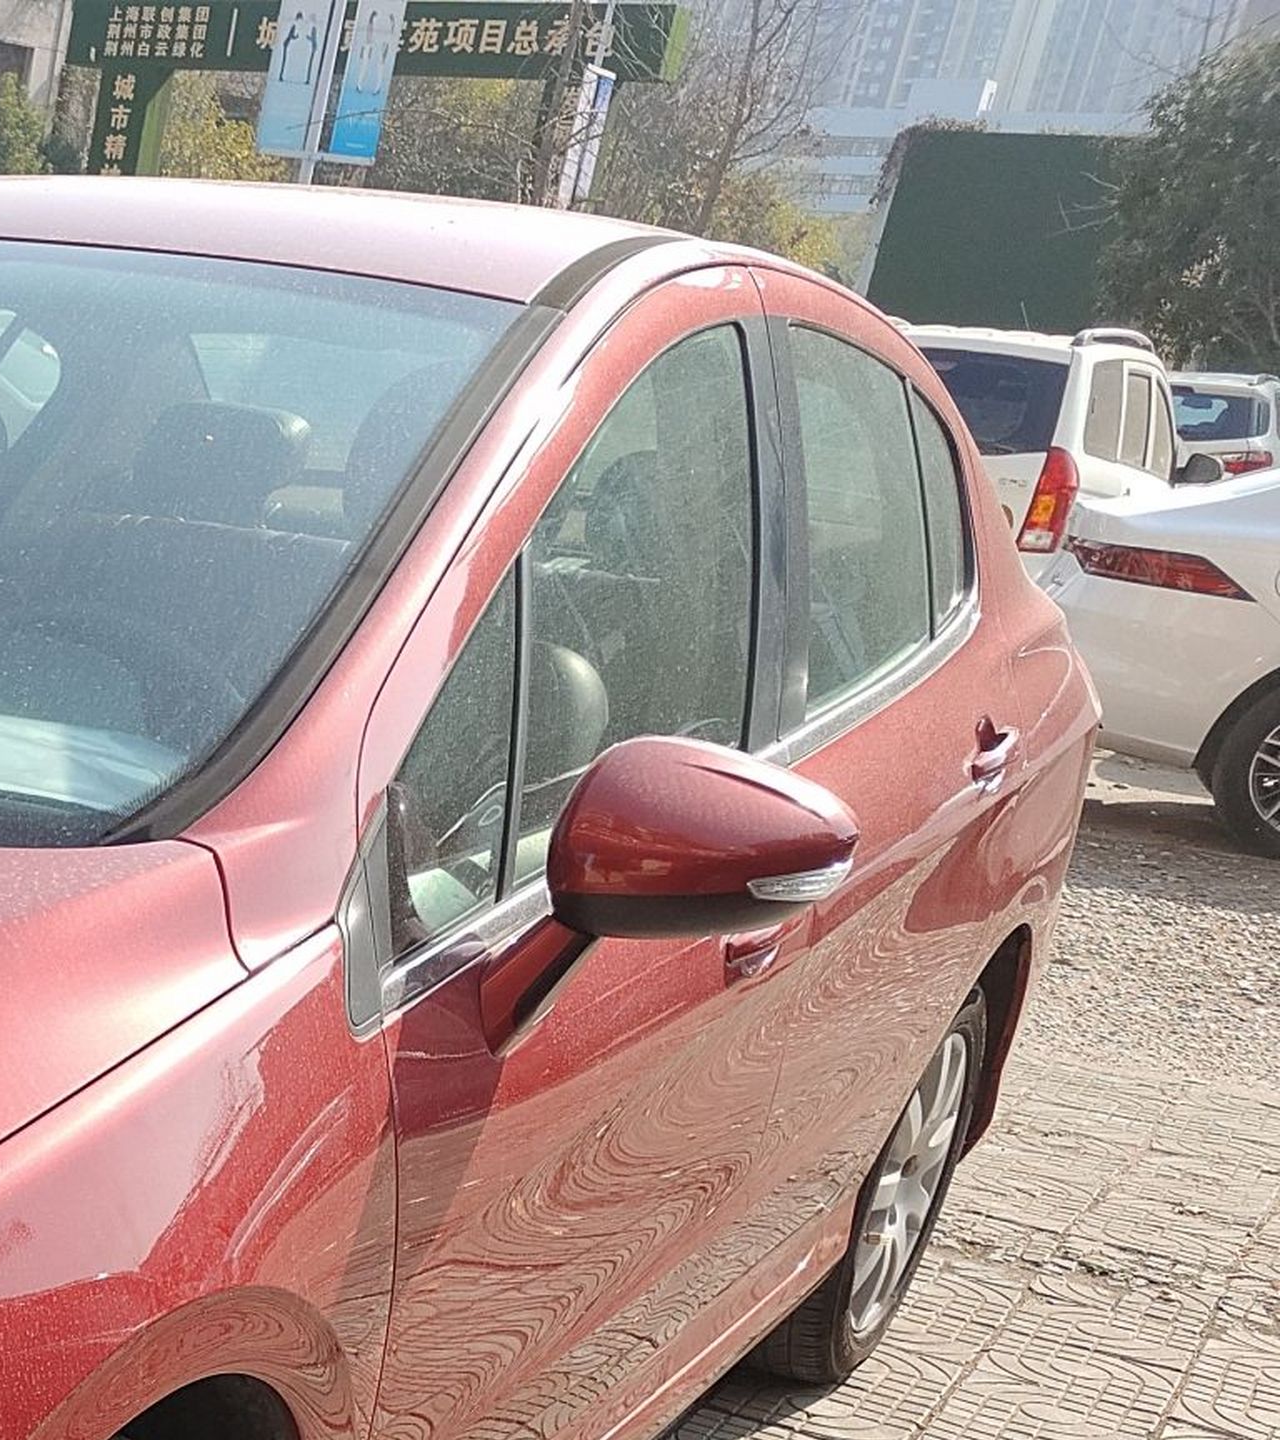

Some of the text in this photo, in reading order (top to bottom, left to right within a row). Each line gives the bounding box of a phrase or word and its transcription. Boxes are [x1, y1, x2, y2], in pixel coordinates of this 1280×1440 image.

[106, 23, 207, 40] 荆州市政集团
[103, 41, 205, 58] 荆州白云绿化
